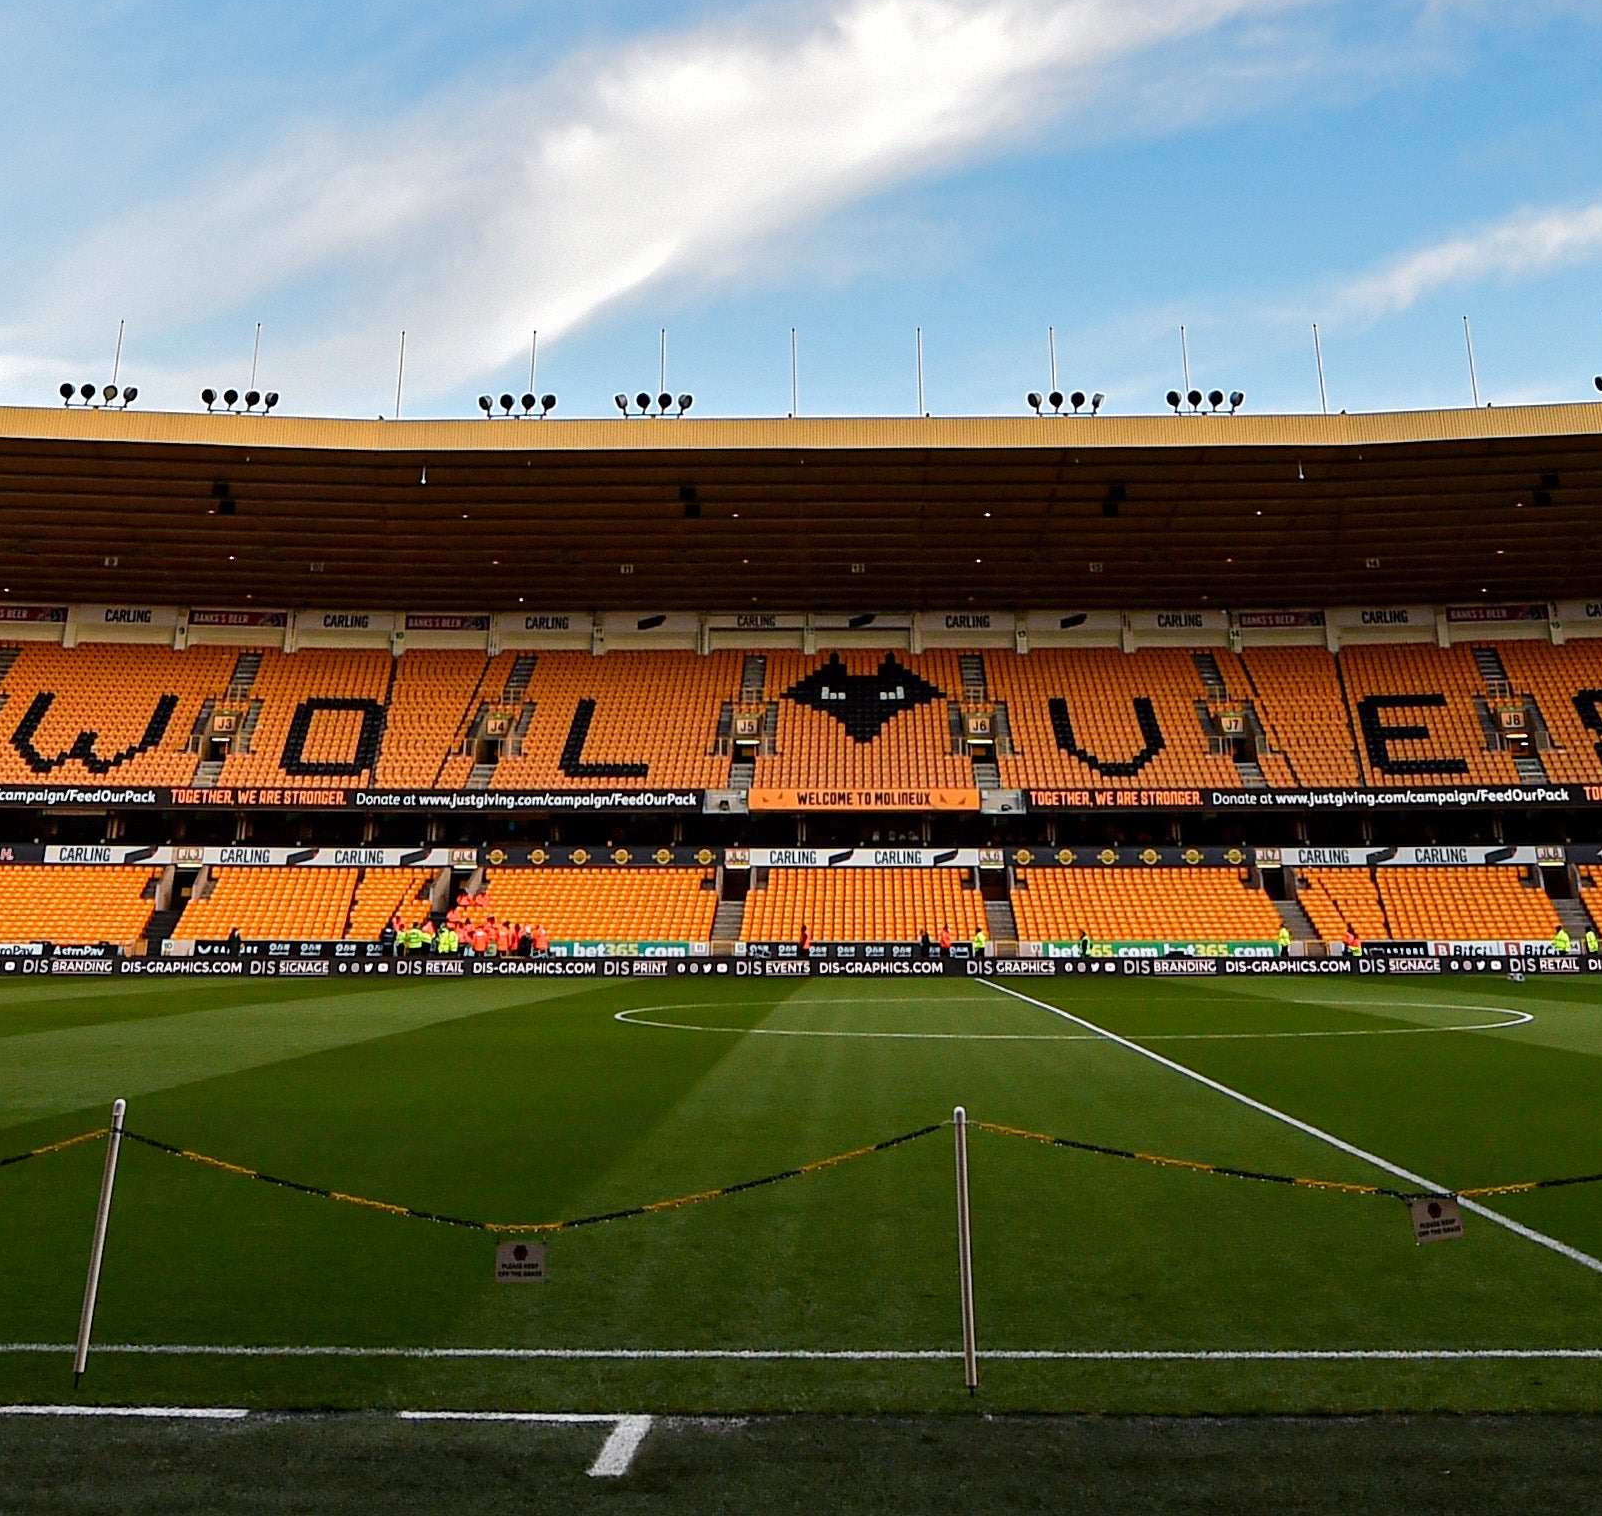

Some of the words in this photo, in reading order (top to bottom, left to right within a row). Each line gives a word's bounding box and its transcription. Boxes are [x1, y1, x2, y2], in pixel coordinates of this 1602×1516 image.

[8, 608, 28, 619] BEER
[105, 609, 151, 623] CARLING
[525, 616, 569, 629] CARLING
[945, 615, 990, 629] CARLING
[1157, 614, 1203, 628] CARLING
[218, 718, 231, 729] J3
[491, 721, 504, 732] J4
[740, 720, 754, 732] J5
[973, 720, 986, 731] J6
[1227, 719, 1239, 730] J7
[1506, 714, 1519, 725] J8
[171, 790, 234, 805] TOGETHER,
[238, 790, 257, 804] WE
[259, 790, 281, 804] ARE
[284, 791, 347, 805] STRONGER.
[357, 792, 400, 805] Donate
[403, 795, 416, 805] at
[419, 792, 697, 809] www.justgiving.com/campaign/FeedOurPack
[797, 793, 853, 805] WELCOME
[857, 793, 871, 805] TO
[874, 793, 931, 805] MOLINEUX
[1030, 791, 1094, 807] TOGETHER,
[1095, 791, 1114, 805] WE
[1117, 791, 1138, 805] ARE
[1141, 791, 1203, 806] STRONGER.
[1213, 793, 1256, 805] Donate
[1260, 795, 1272, 805] at
[1275, 788, 1569, 807] www.justgiving.com/campaign/FeedOurPack
[59, 848, 111, 863] CARLING
[220, 849, 270, 863] CARLING
[335, 849, 384, 864] CARLING
[770, 850, 817, 865] CARLING
[875, 850, 921, 865] CARLING
[1298, 849, 1349, 864] CARLING
[1415, 849, 1468, 863] CARLING
[572, 942, 686, 958] bet365.com
[1048, 943, 1158, 958] bet65.com
[22, 960, 49, 973] DIS
[52, 960, 112, 973] BRANDING
[121, 961, 242, 974] DIS-GRAPHICS.COM
[250, 961, 276, 975] DIS
[279, 962, 329, 974] SIGNAGE
[736, 961, 762, 976] DIS
[765, 962, 810, 974] EVENTS
[819, 961, 944, 974] DIS-GRAPHICS.COM
[1123, 961, 1150, 975] DIS
[1153, 962, 1217, 973] BRANDING
[1225, 960, 1351, 973] DIS-GRAPHICS.COM
[1509, 959, 1536, 973] DIS
[1540, 959, 1580, 971] RETAIL
